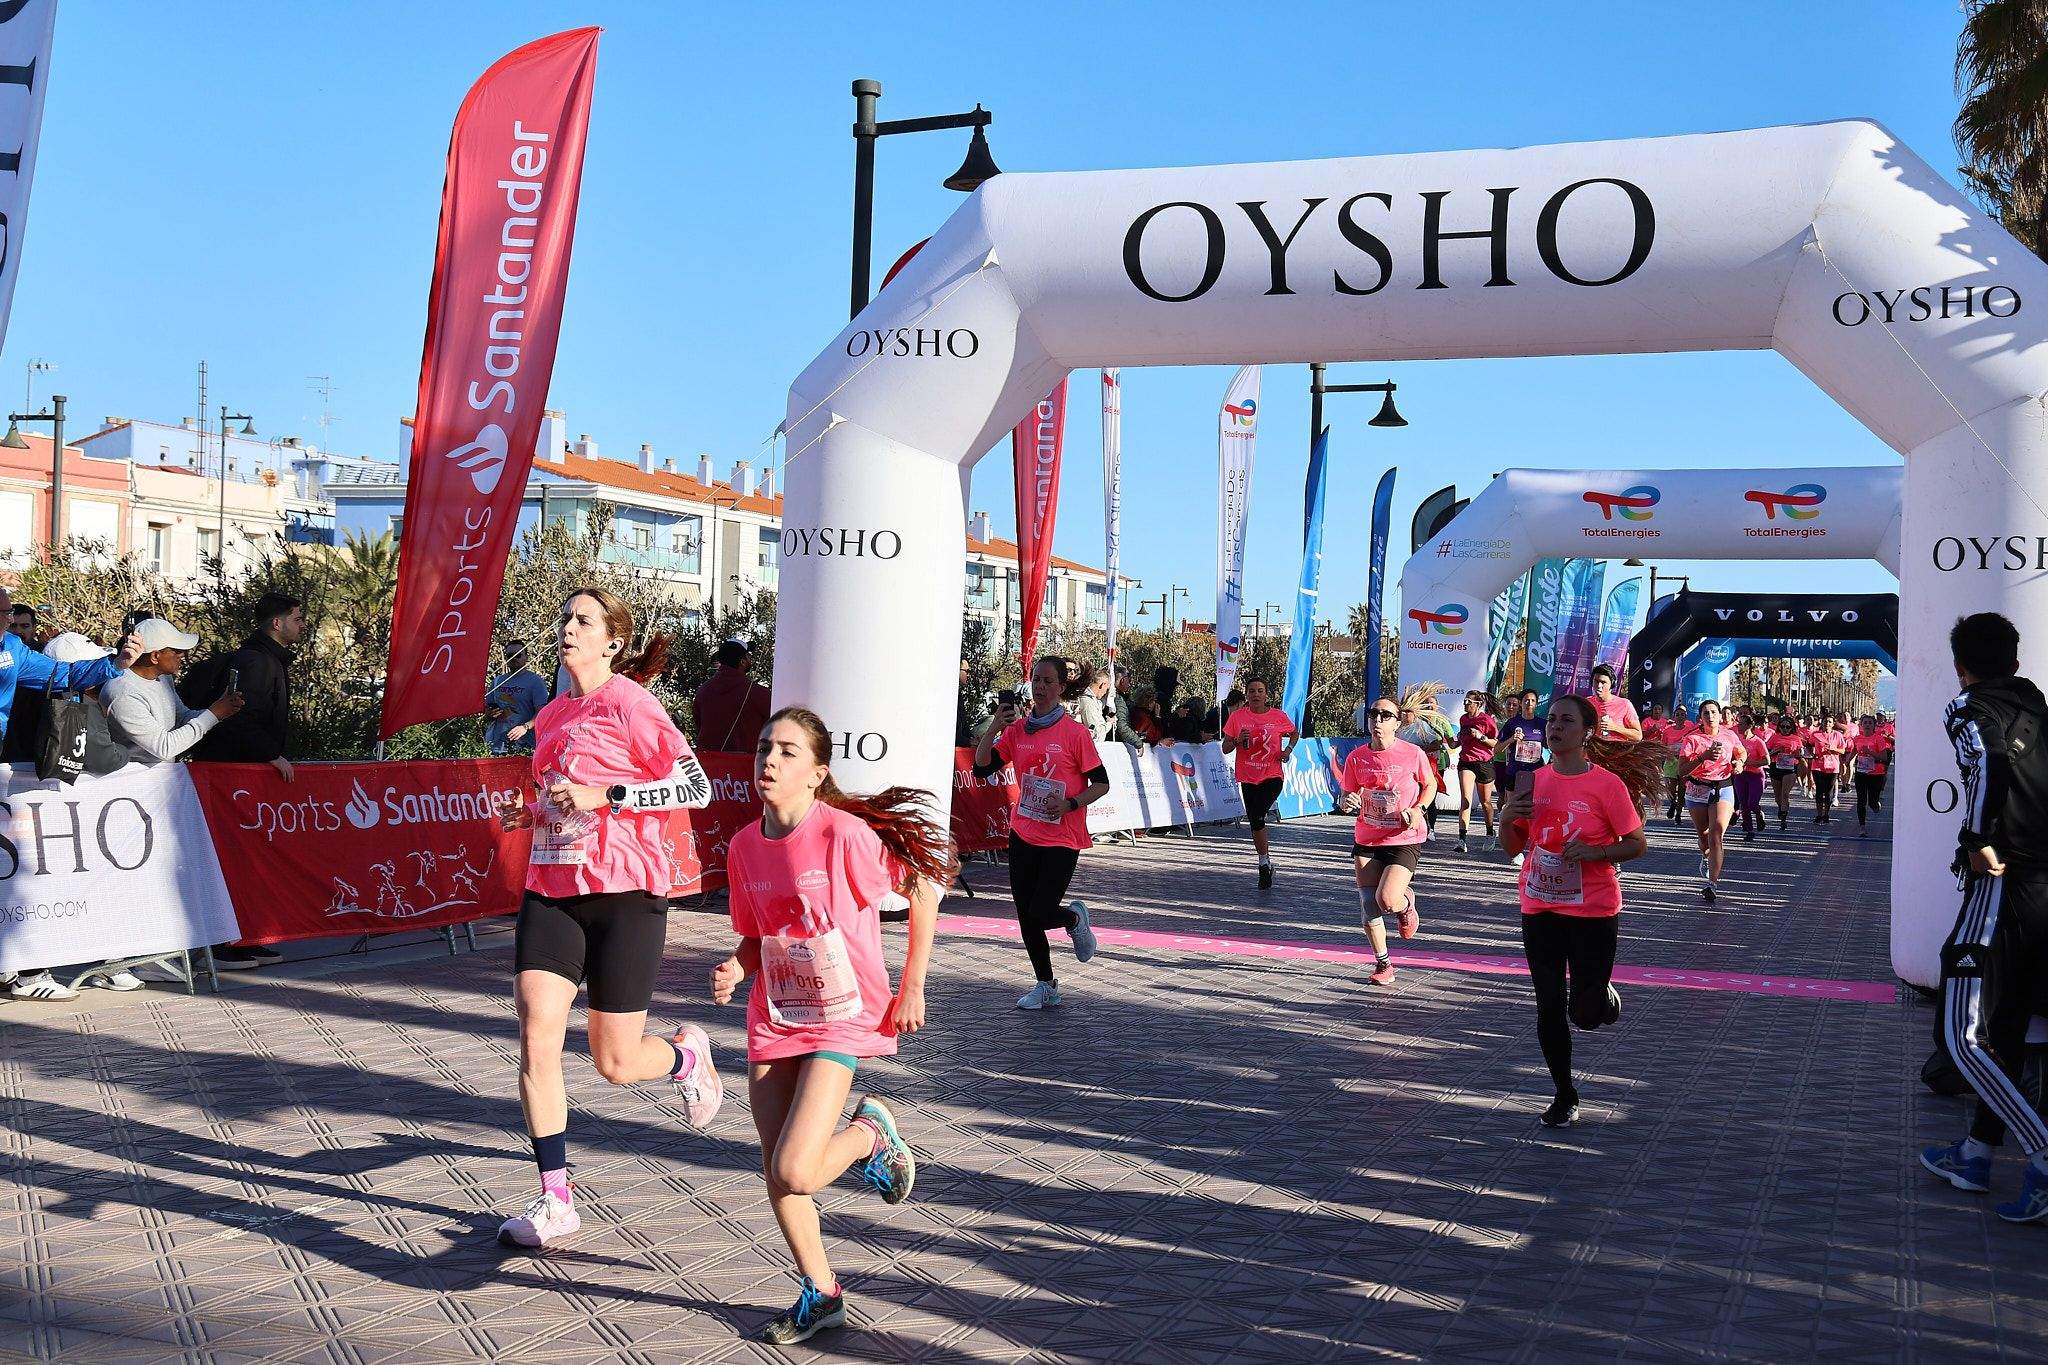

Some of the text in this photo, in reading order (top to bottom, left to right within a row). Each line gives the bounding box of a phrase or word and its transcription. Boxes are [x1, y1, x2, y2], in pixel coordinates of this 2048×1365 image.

[1123, 178, 1656, 303] OYSHO
[1832, 285, 2022, 327] OYSHO
[846, 327, 979, 359] OYSHO
[420, 120, 549, 675] Sports Santander
[783, 527, 902, 560] OYSHO
[1581, 527, 1661, 540] TotalEnergies
[1743, 526, 1827, 539] TotalEnergies
[1527, 567, 1562, 677] Batiste
[1713, 608, 1860, 623] VOLVO
[1406, 640, 1468, 652] TotalEnergies
[233, 789, 341, 841] Sports
[0, 900, 88, 924] YSHO.COM
